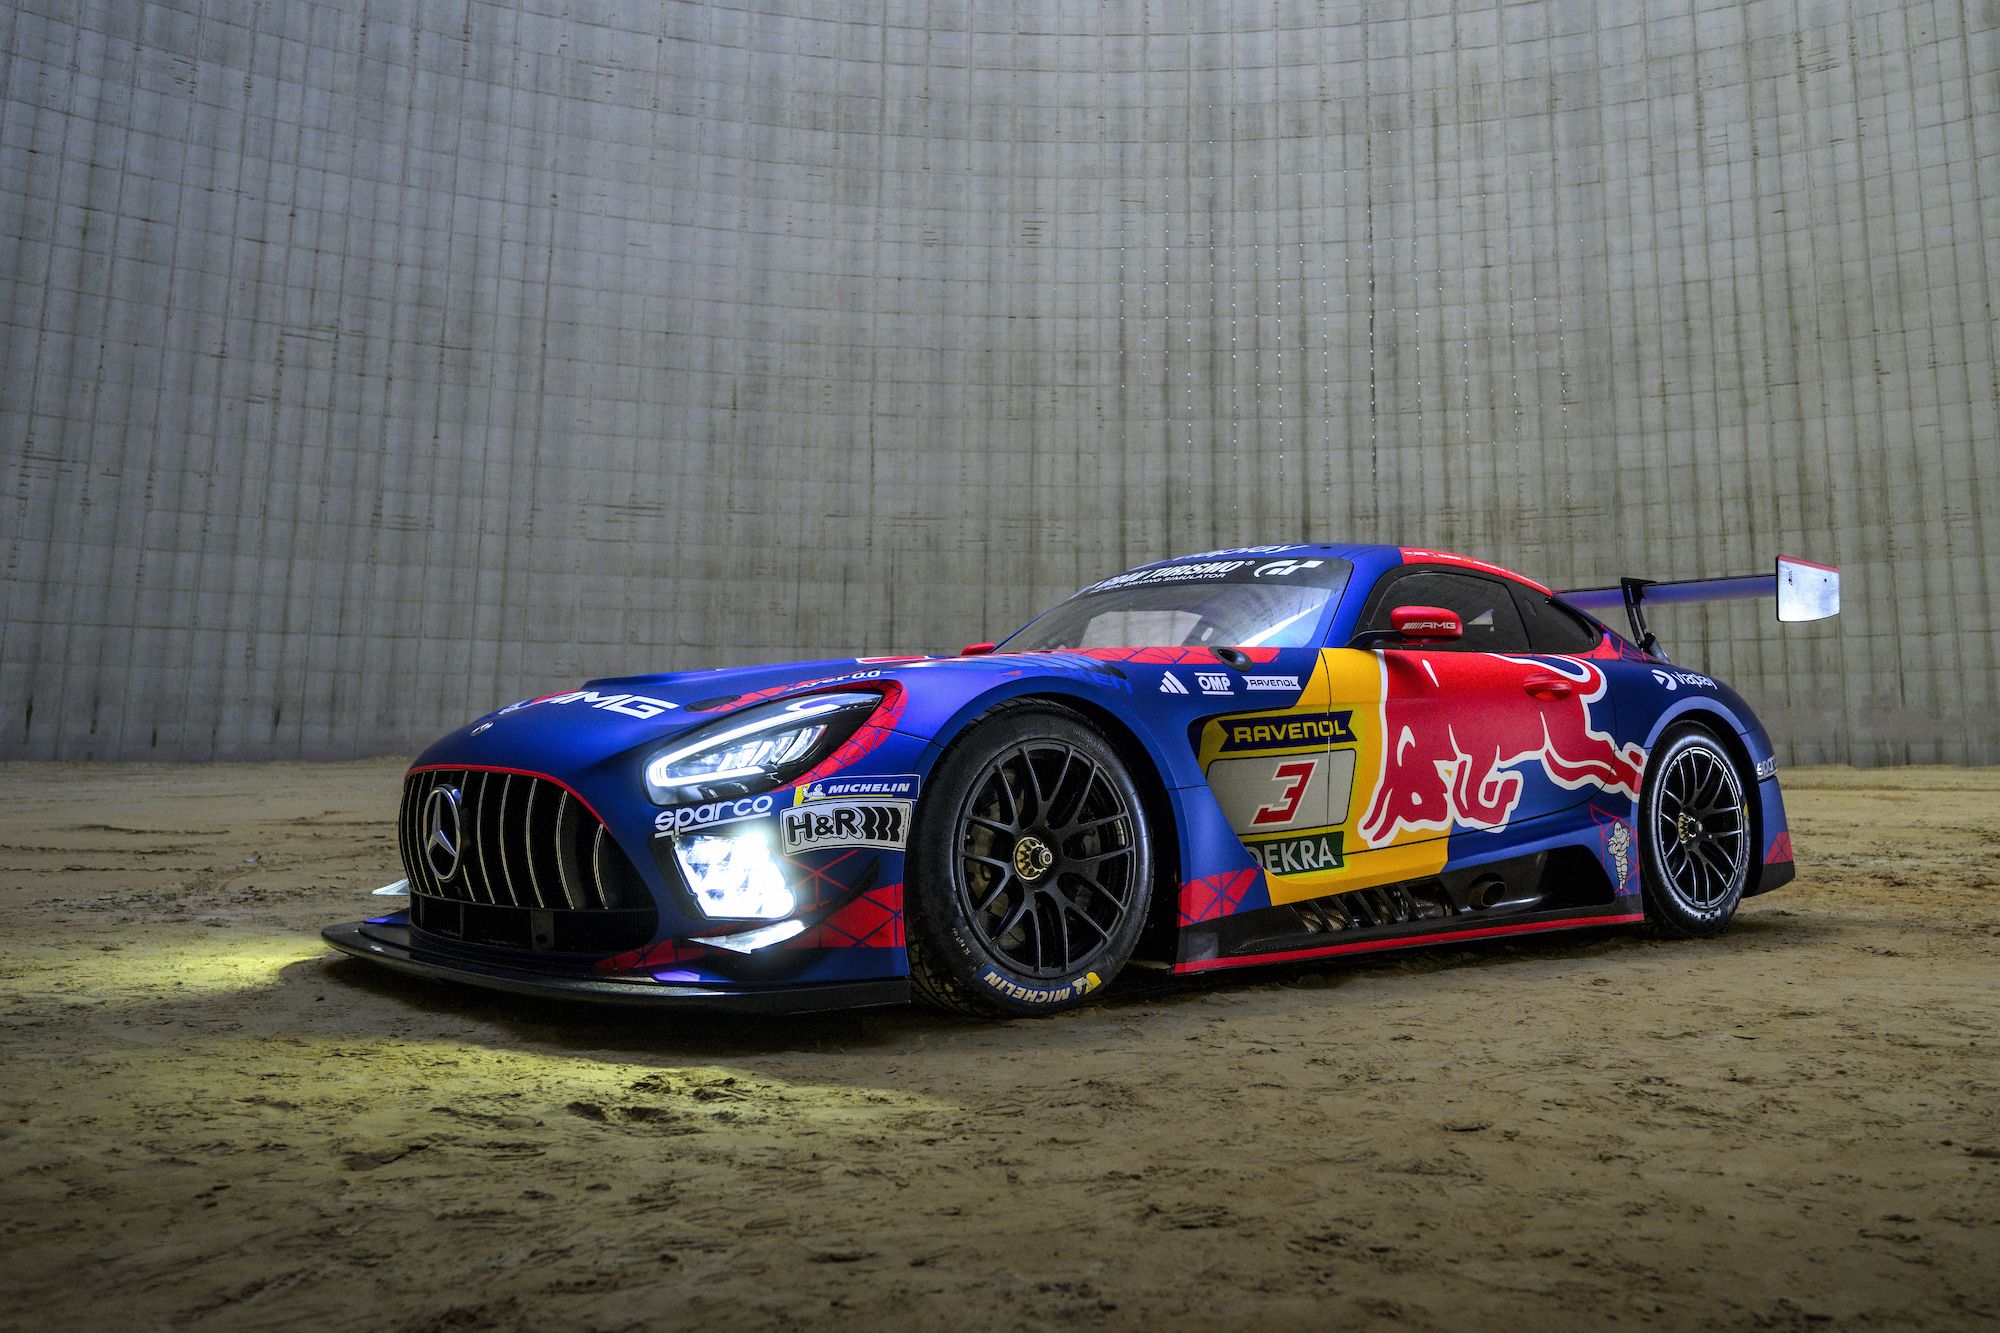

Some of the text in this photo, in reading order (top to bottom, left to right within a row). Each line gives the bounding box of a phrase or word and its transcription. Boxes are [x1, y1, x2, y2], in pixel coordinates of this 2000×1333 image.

[1143, 561, 1245, 580] TURISMO
[1162, 573, 1226, 582] SIMULATOR
[1420, 622, 1457, 630] AMG
[1197, 676, 1231, 691] OMP
[1249, 679, 1297, 687] RAVENOL
[1233, 720, 1347, 743] RAVENOL
[828, 782, 911, 794] MICHELIN
[1248, 759, 1319, 827] 3
[655, 795, 774, 835] sparco
[787, 806, 862, 844] H&R
[983, 971, 1071, 1003] MICHELIN
